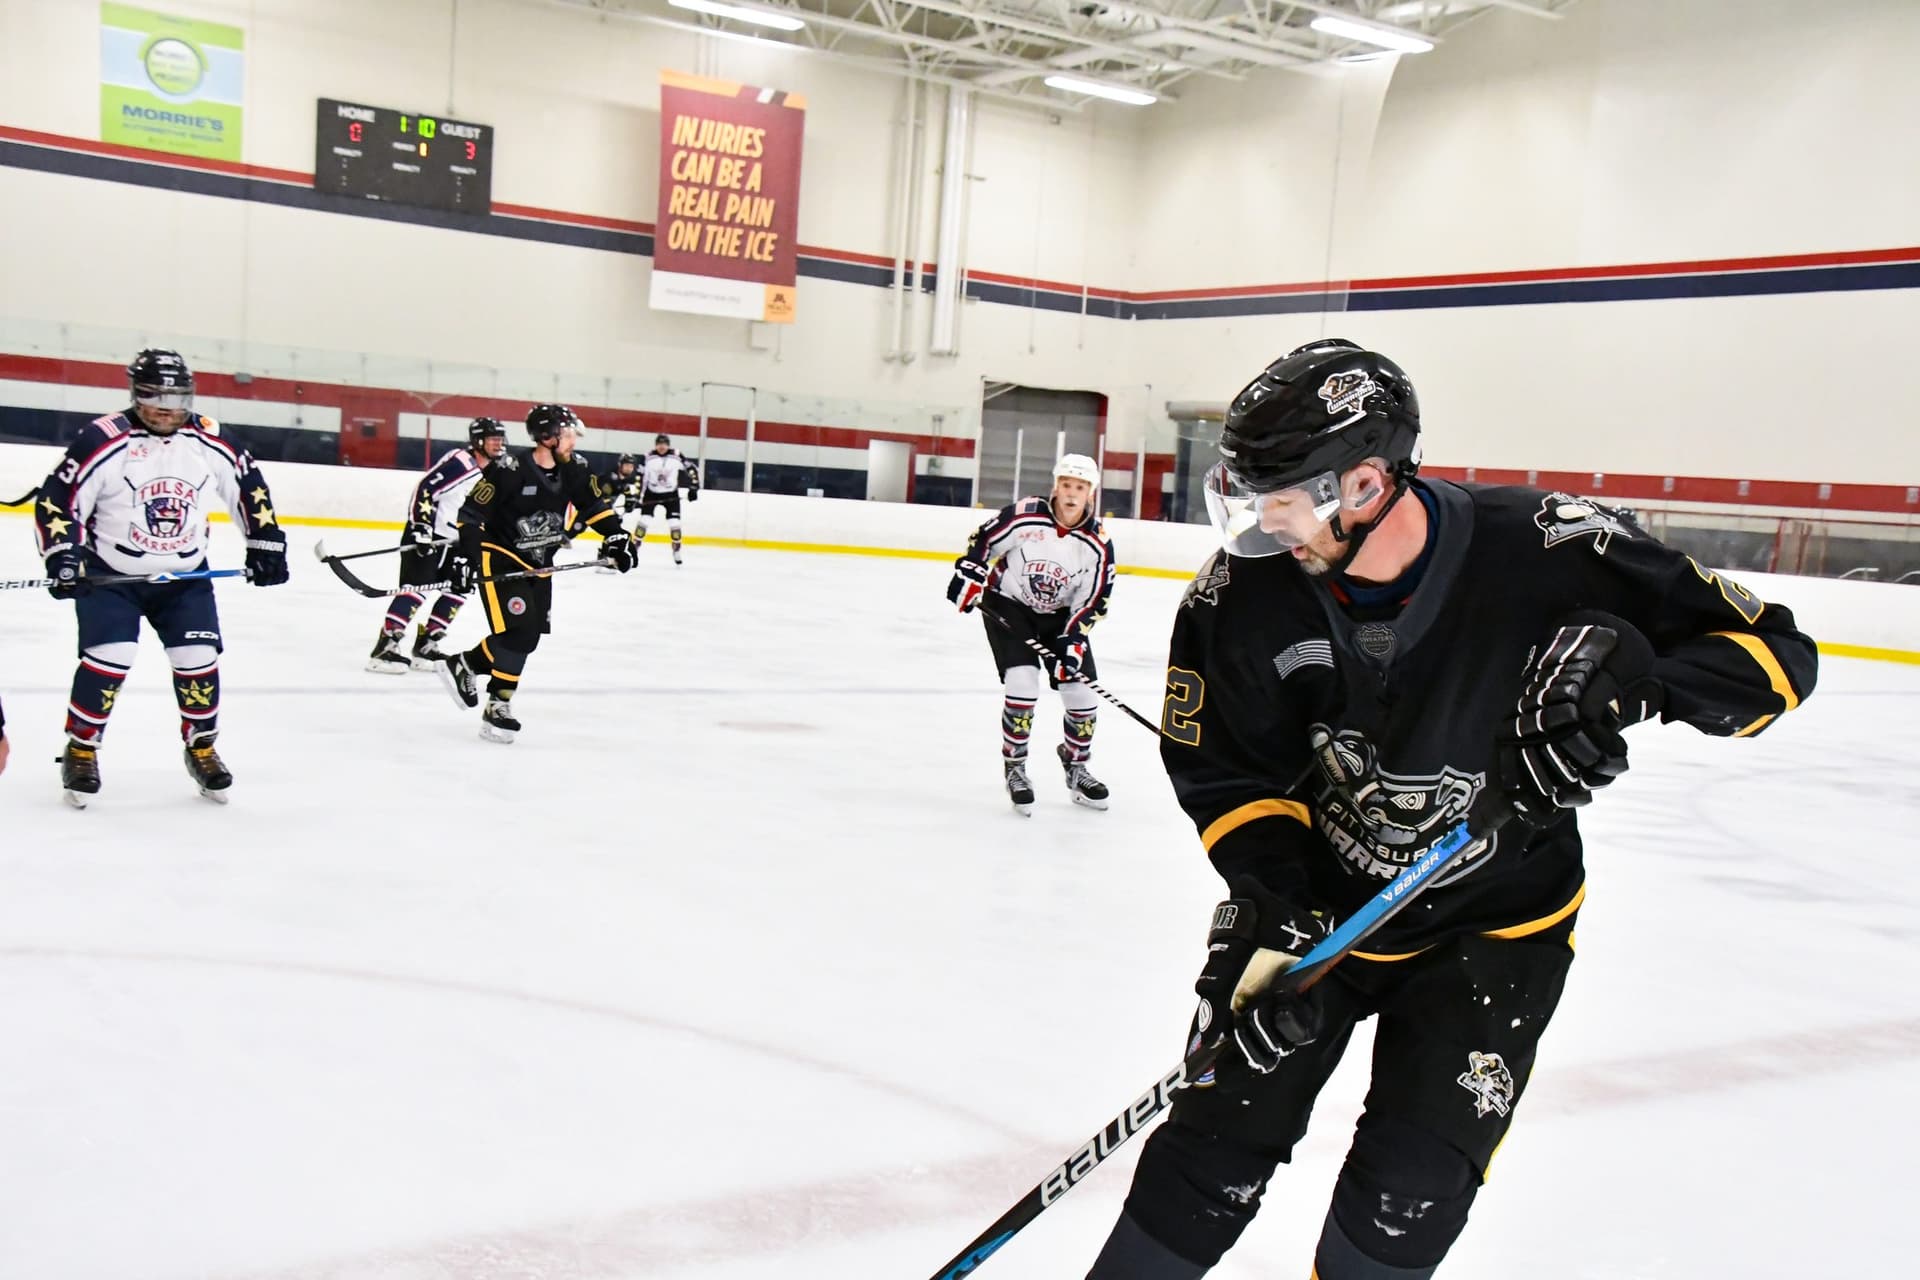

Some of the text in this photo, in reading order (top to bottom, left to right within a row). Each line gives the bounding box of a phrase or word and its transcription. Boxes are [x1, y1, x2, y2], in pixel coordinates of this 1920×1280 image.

[122, 104, 224, 131] MORRIE'S
[338, 105, 375, 123] HOME
[441, 123, 481, 139] GUEST
[671, 114, 766, 158] INJURIES
[464, 141, 476, 160] 3
[671, 151, 762, 193] CAN BE A
[668, 184, 776, 228] REAL PAIN
[668, 220, 778, 262] ON THE ICE
[139, 481, 195, 501] TULSA
[960, 560, 988, 577] CC
[1026, 562, 1070, 586] TUSA
[1162, 665, 1205, 746] 2
[1328, 802, 1450, 862] PITSBUR
